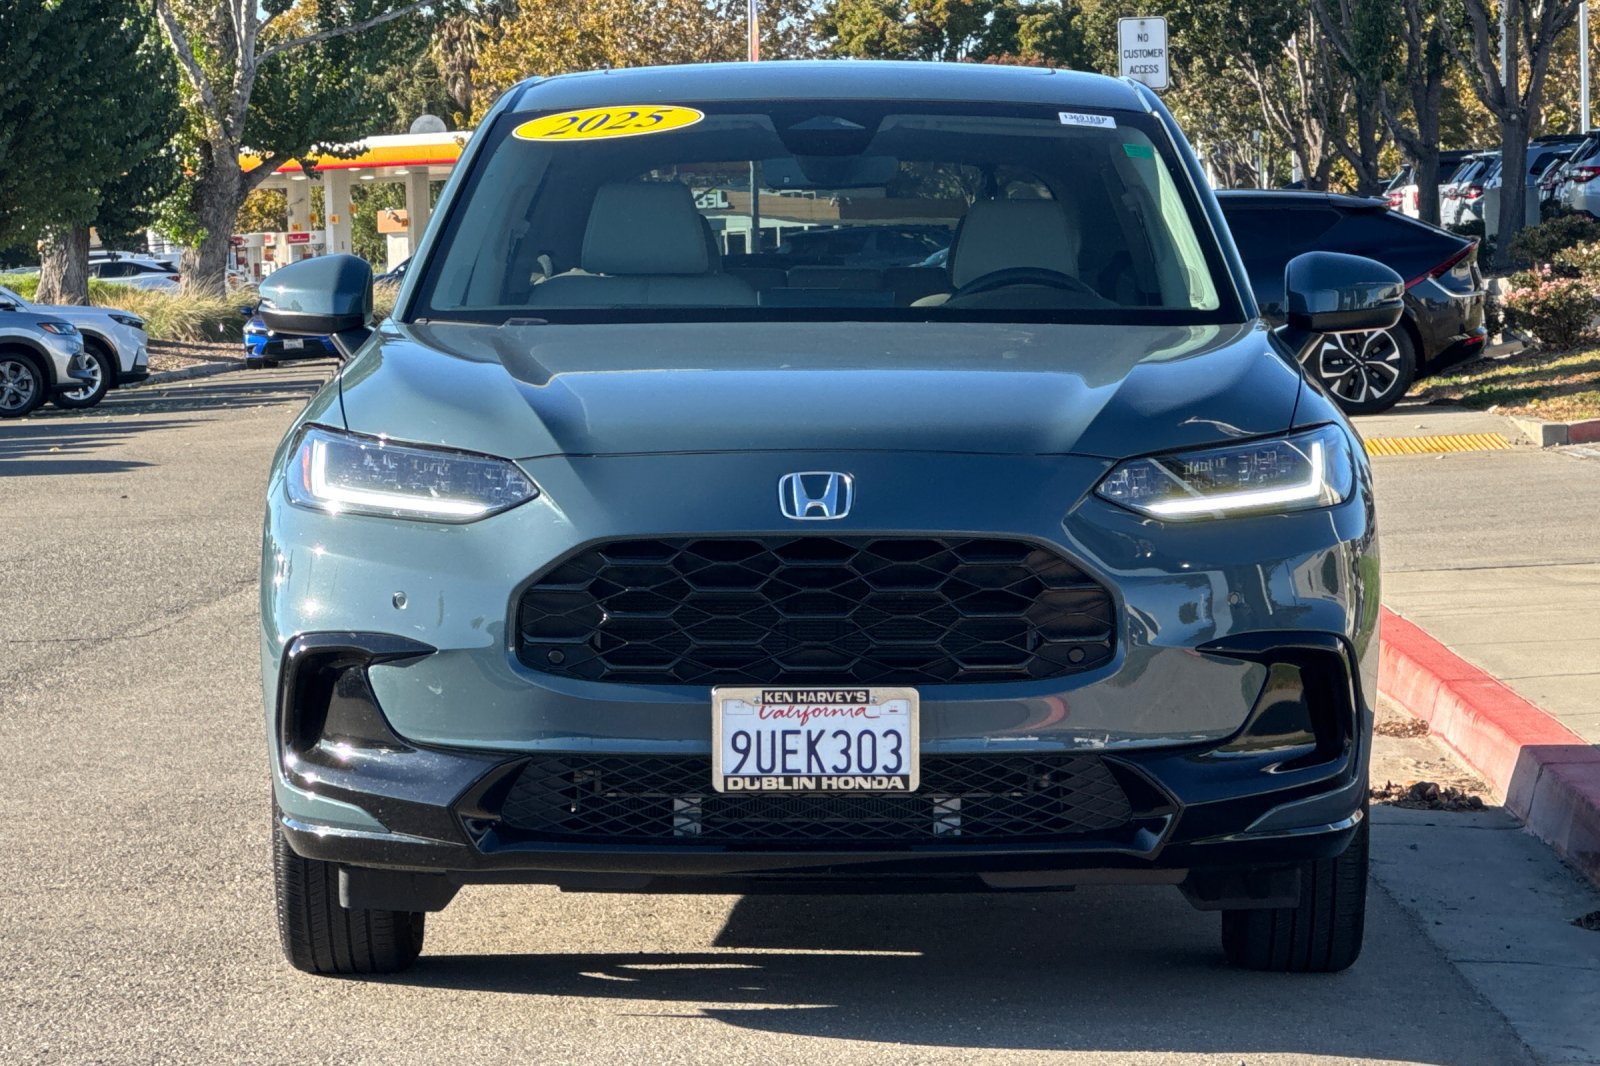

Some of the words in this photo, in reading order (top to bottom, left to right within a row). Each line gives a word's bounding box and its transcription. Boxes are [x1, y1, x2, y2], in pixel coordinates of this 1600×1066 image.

[1137, 33, 1149, 42] NO
[1123, 49, 1164, 59] CUSTOMER
[1129, 65, 1159, 74] ACCESS
[541, 110, 673, 136] 2025
[764, 691, 794, 703] KEN
[796, 691, 867, 703] HARVEY'S
[758, 704, 880, 727] California
[730, 728, 903, 774] 9UEK303
[726, 776, 817, 791] DUBLIN
[821, 776, 905, 791] HONDA
